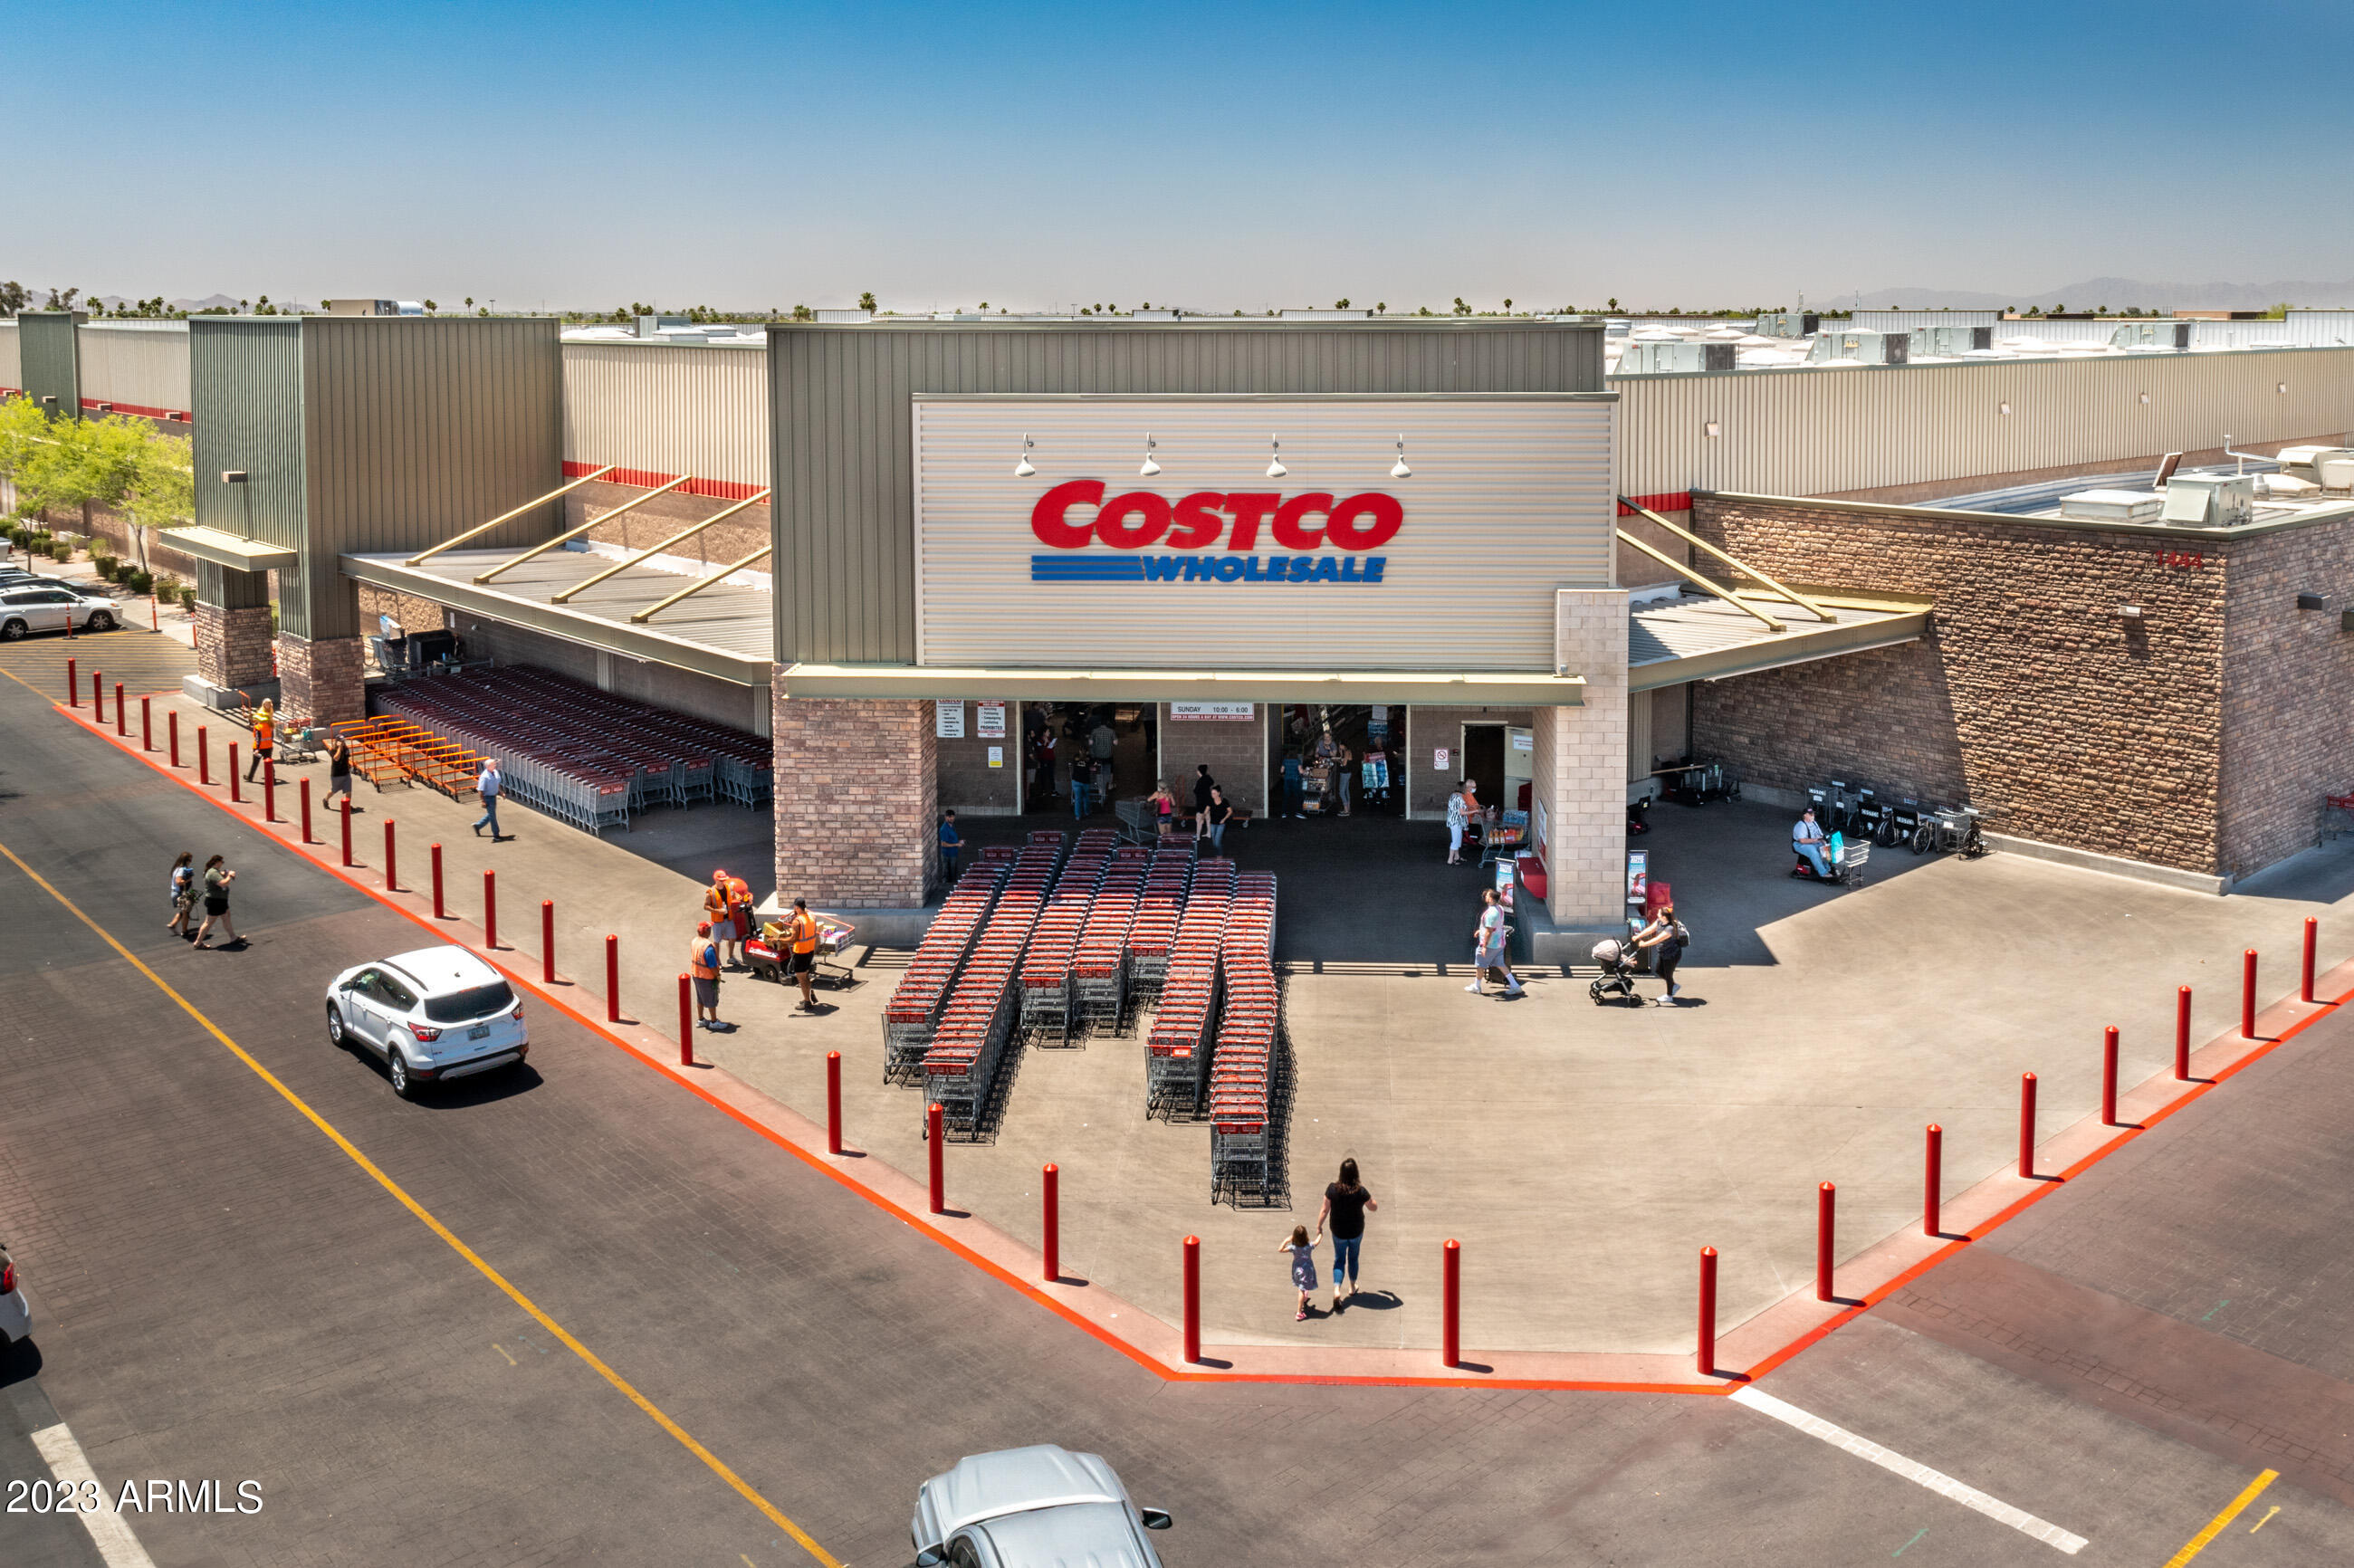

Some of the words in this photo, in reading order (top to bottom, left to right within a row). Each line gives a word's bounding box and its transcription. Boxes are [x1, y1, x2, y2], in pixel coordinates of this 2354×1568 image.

[1030, 479, 1403, 551] COSTCO
[1142, 555, 1387, 583] WHOLESALE
[2154, 549, 2203, 569] 1444
